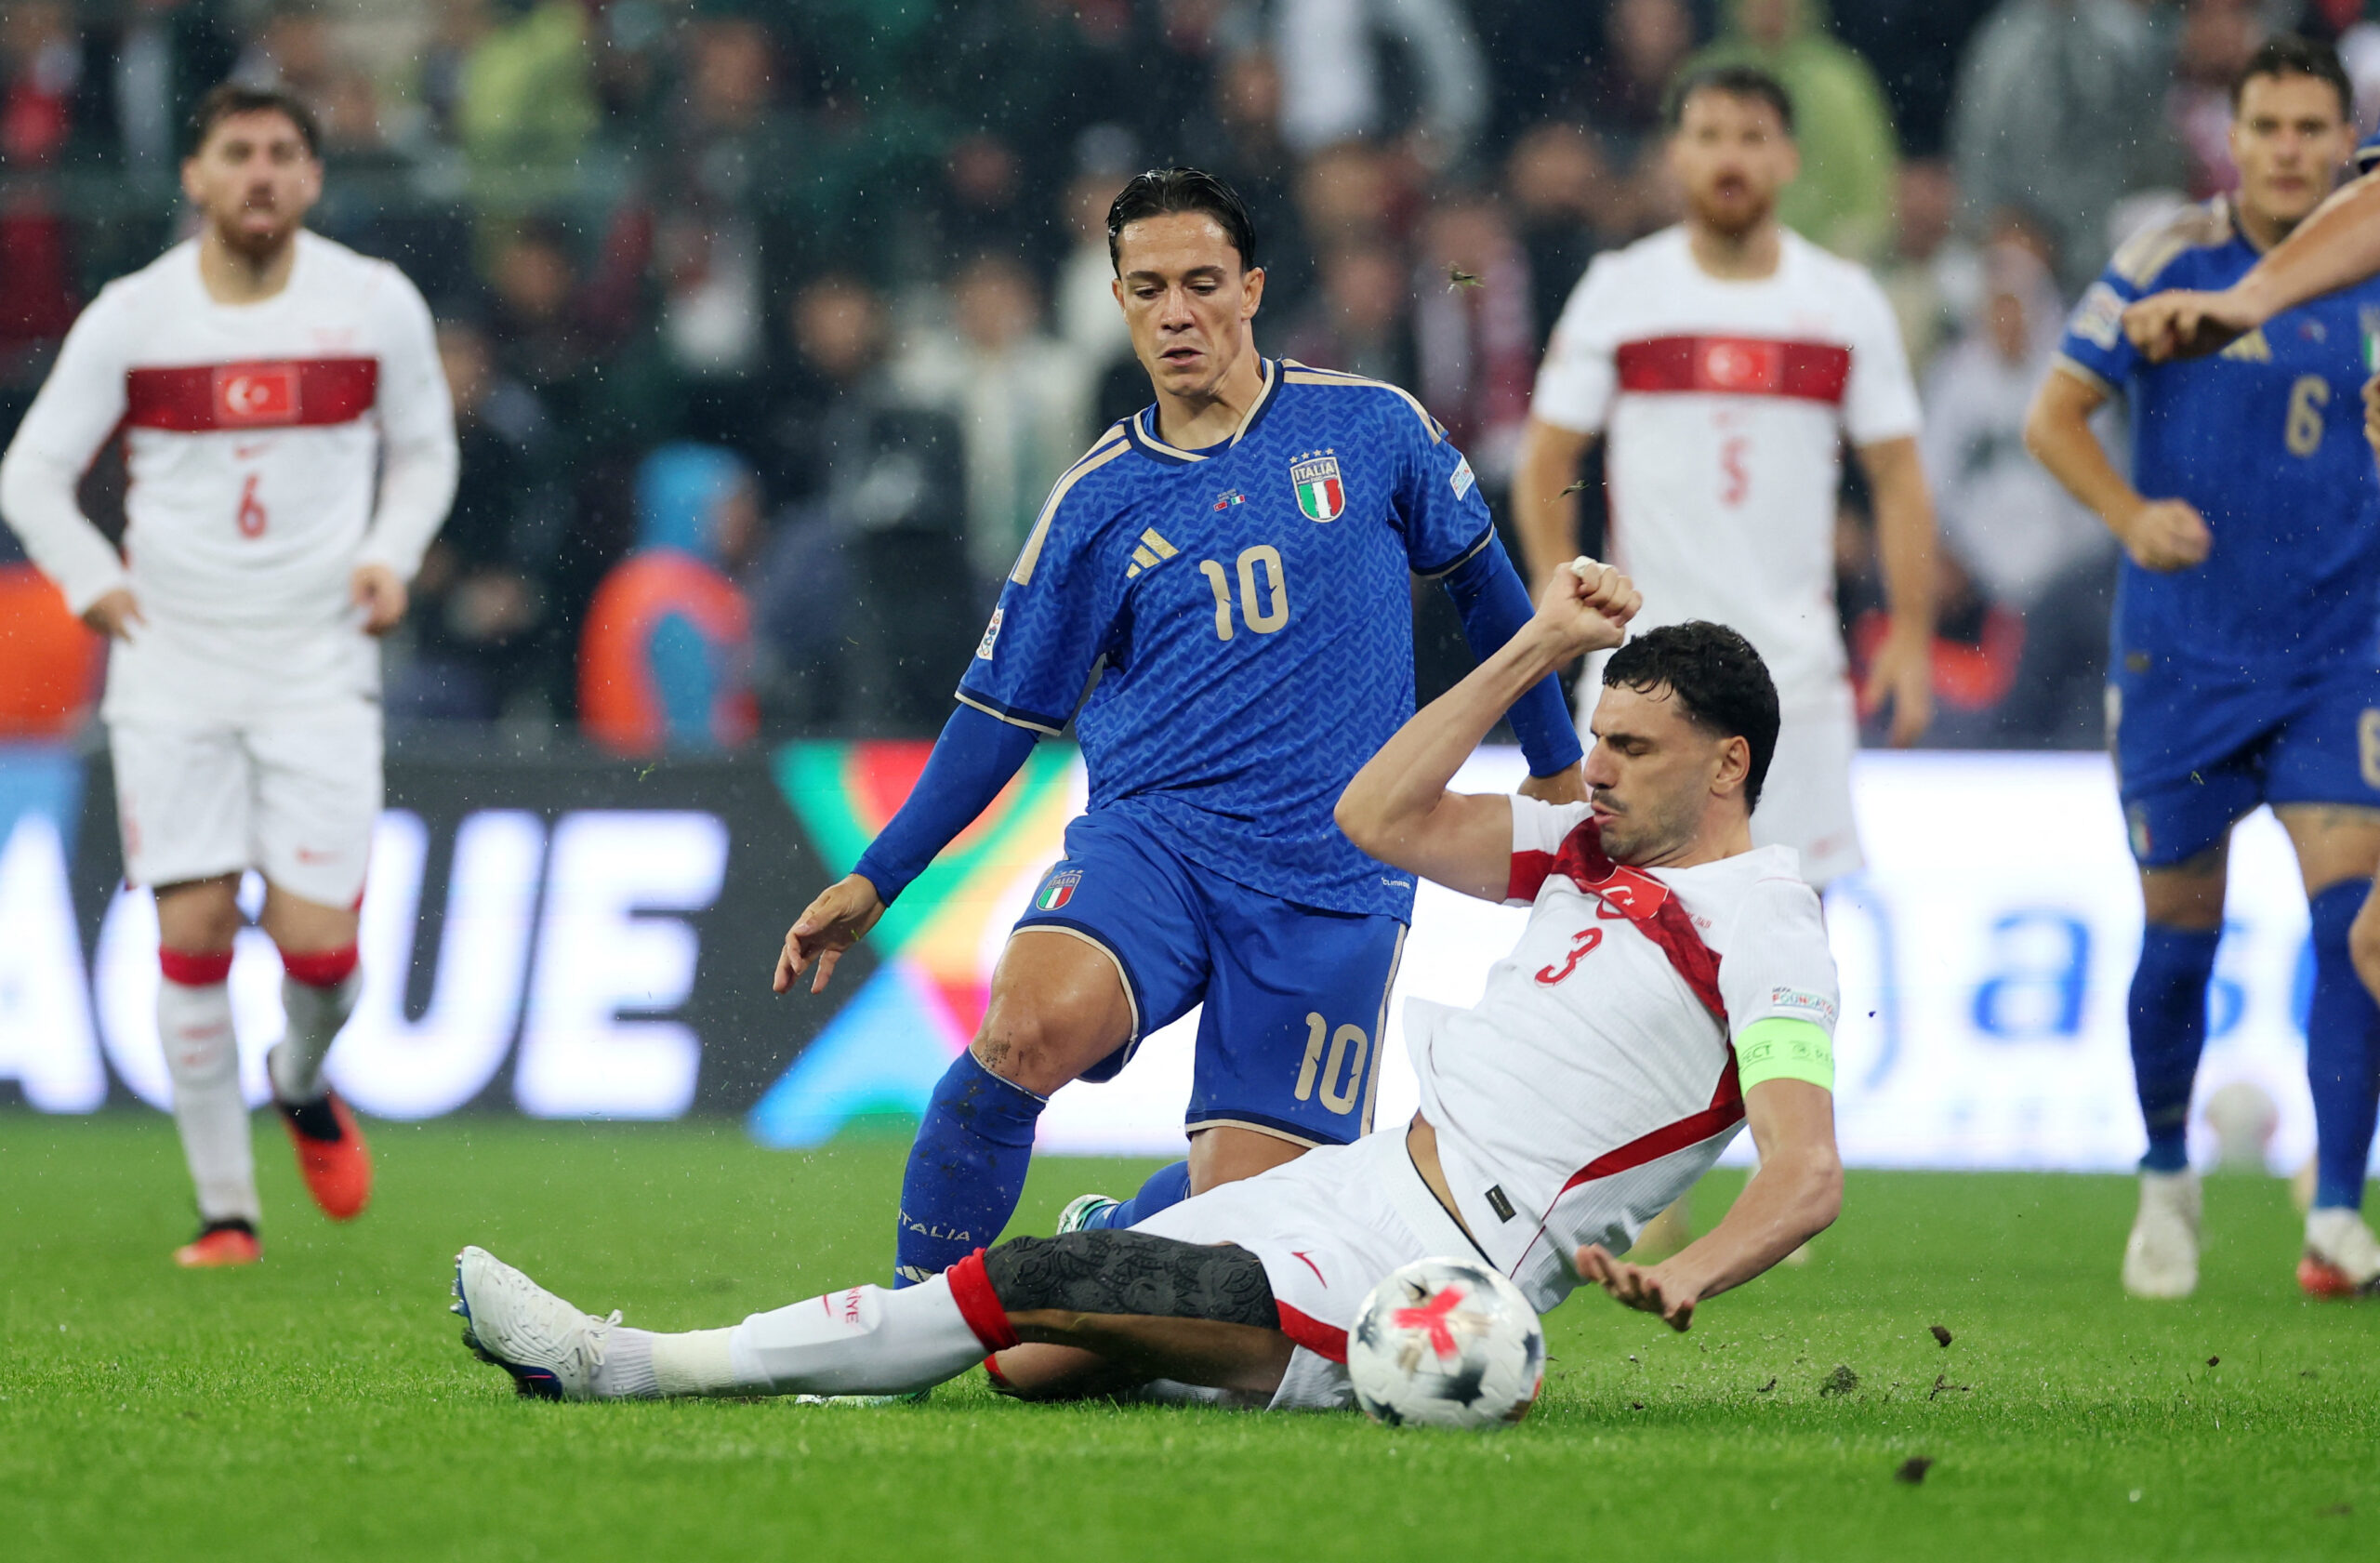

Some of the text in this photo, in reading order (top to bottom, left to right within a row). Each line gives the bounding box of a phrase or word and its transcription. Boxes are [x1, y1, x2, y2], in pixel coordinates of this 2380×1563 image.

[2285, 375, 2329, 457] 6
[1294, 461, 1336, 481] ITALIA
[1720, 435, 1752, 508] 5
[236, 474, 268, 539] 6
[1199, 544, 1289, 642] 10
[1534, 926, 1603, 988] 3
[1293, 1012, 1368, 1116] 10
[897, 1207, 971, 1242] ITALIA
